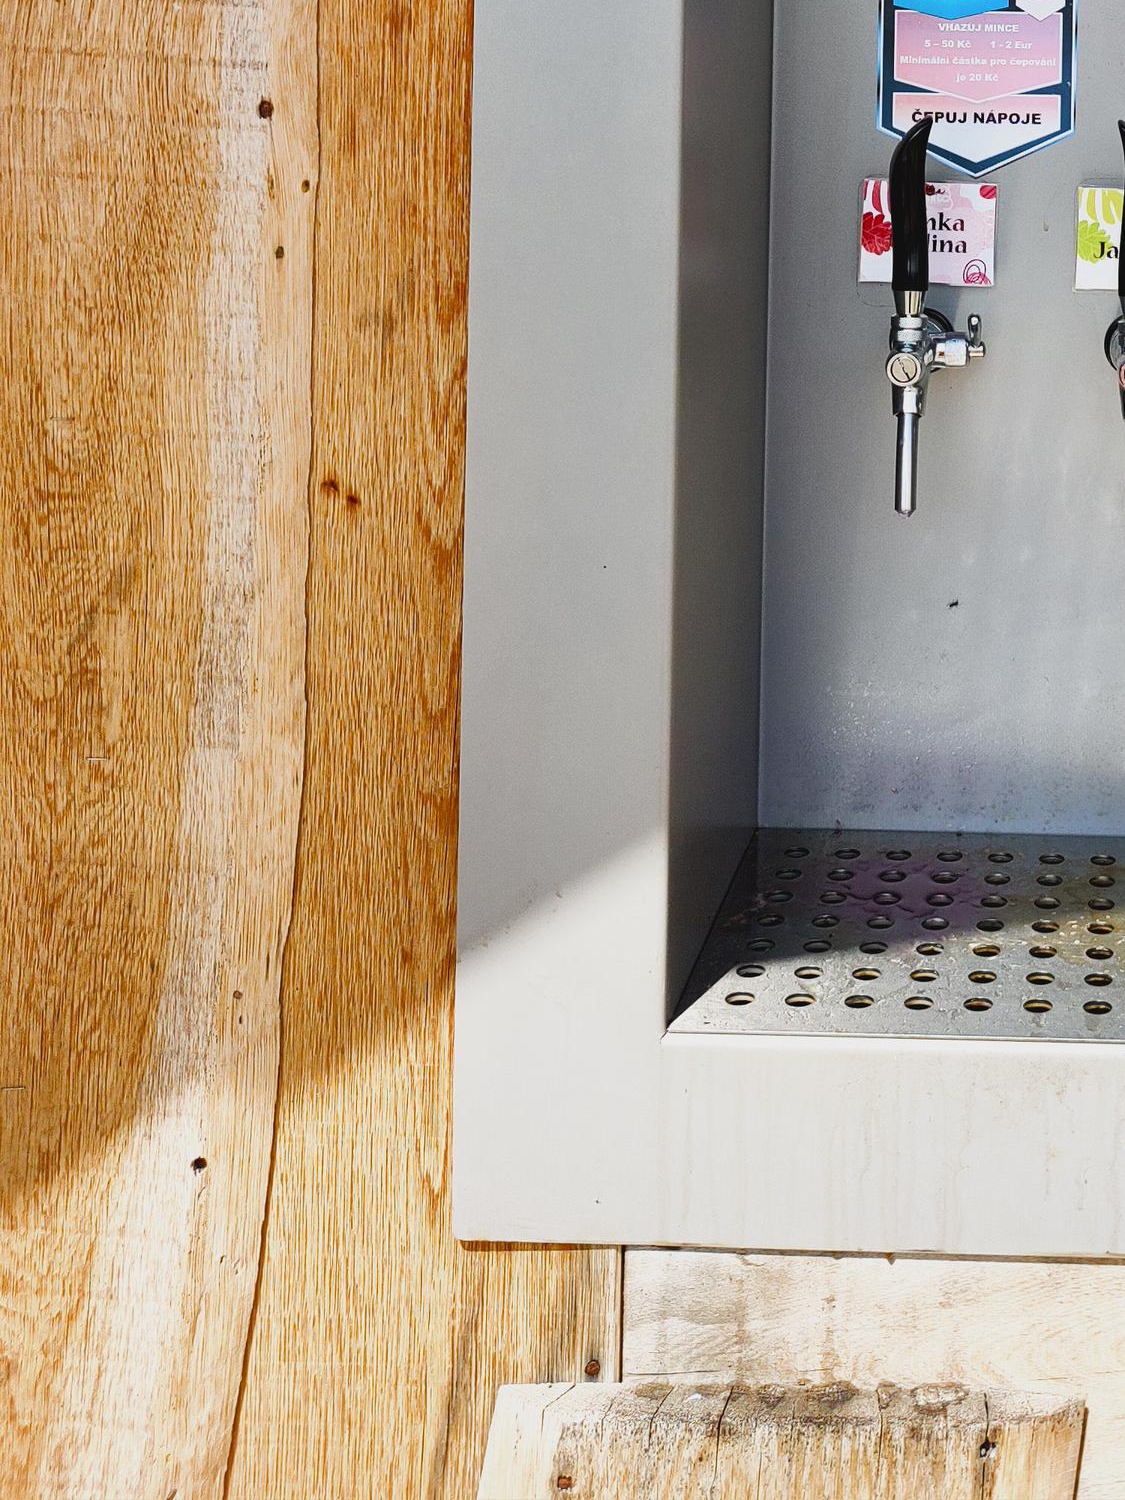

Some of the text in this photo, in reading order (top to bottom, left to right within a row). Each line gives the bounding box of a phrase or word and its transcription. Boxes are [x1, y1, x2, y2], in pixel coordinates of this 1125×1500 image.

[938, 23, 1019, 33] VHAZUJ MINCE
[924, 40, 931, 48] 5
[941, 40, 954, 48] 50
[958, 39, 972, 48] Kč
[1015, 41, 1032, 49] Eur
[990, 58, 1007, 66] pro
[956, 74, 966, 82] je
[985, 73, 998, 82] Kč
[973, 110, 1042, 125] NÁPOJE
